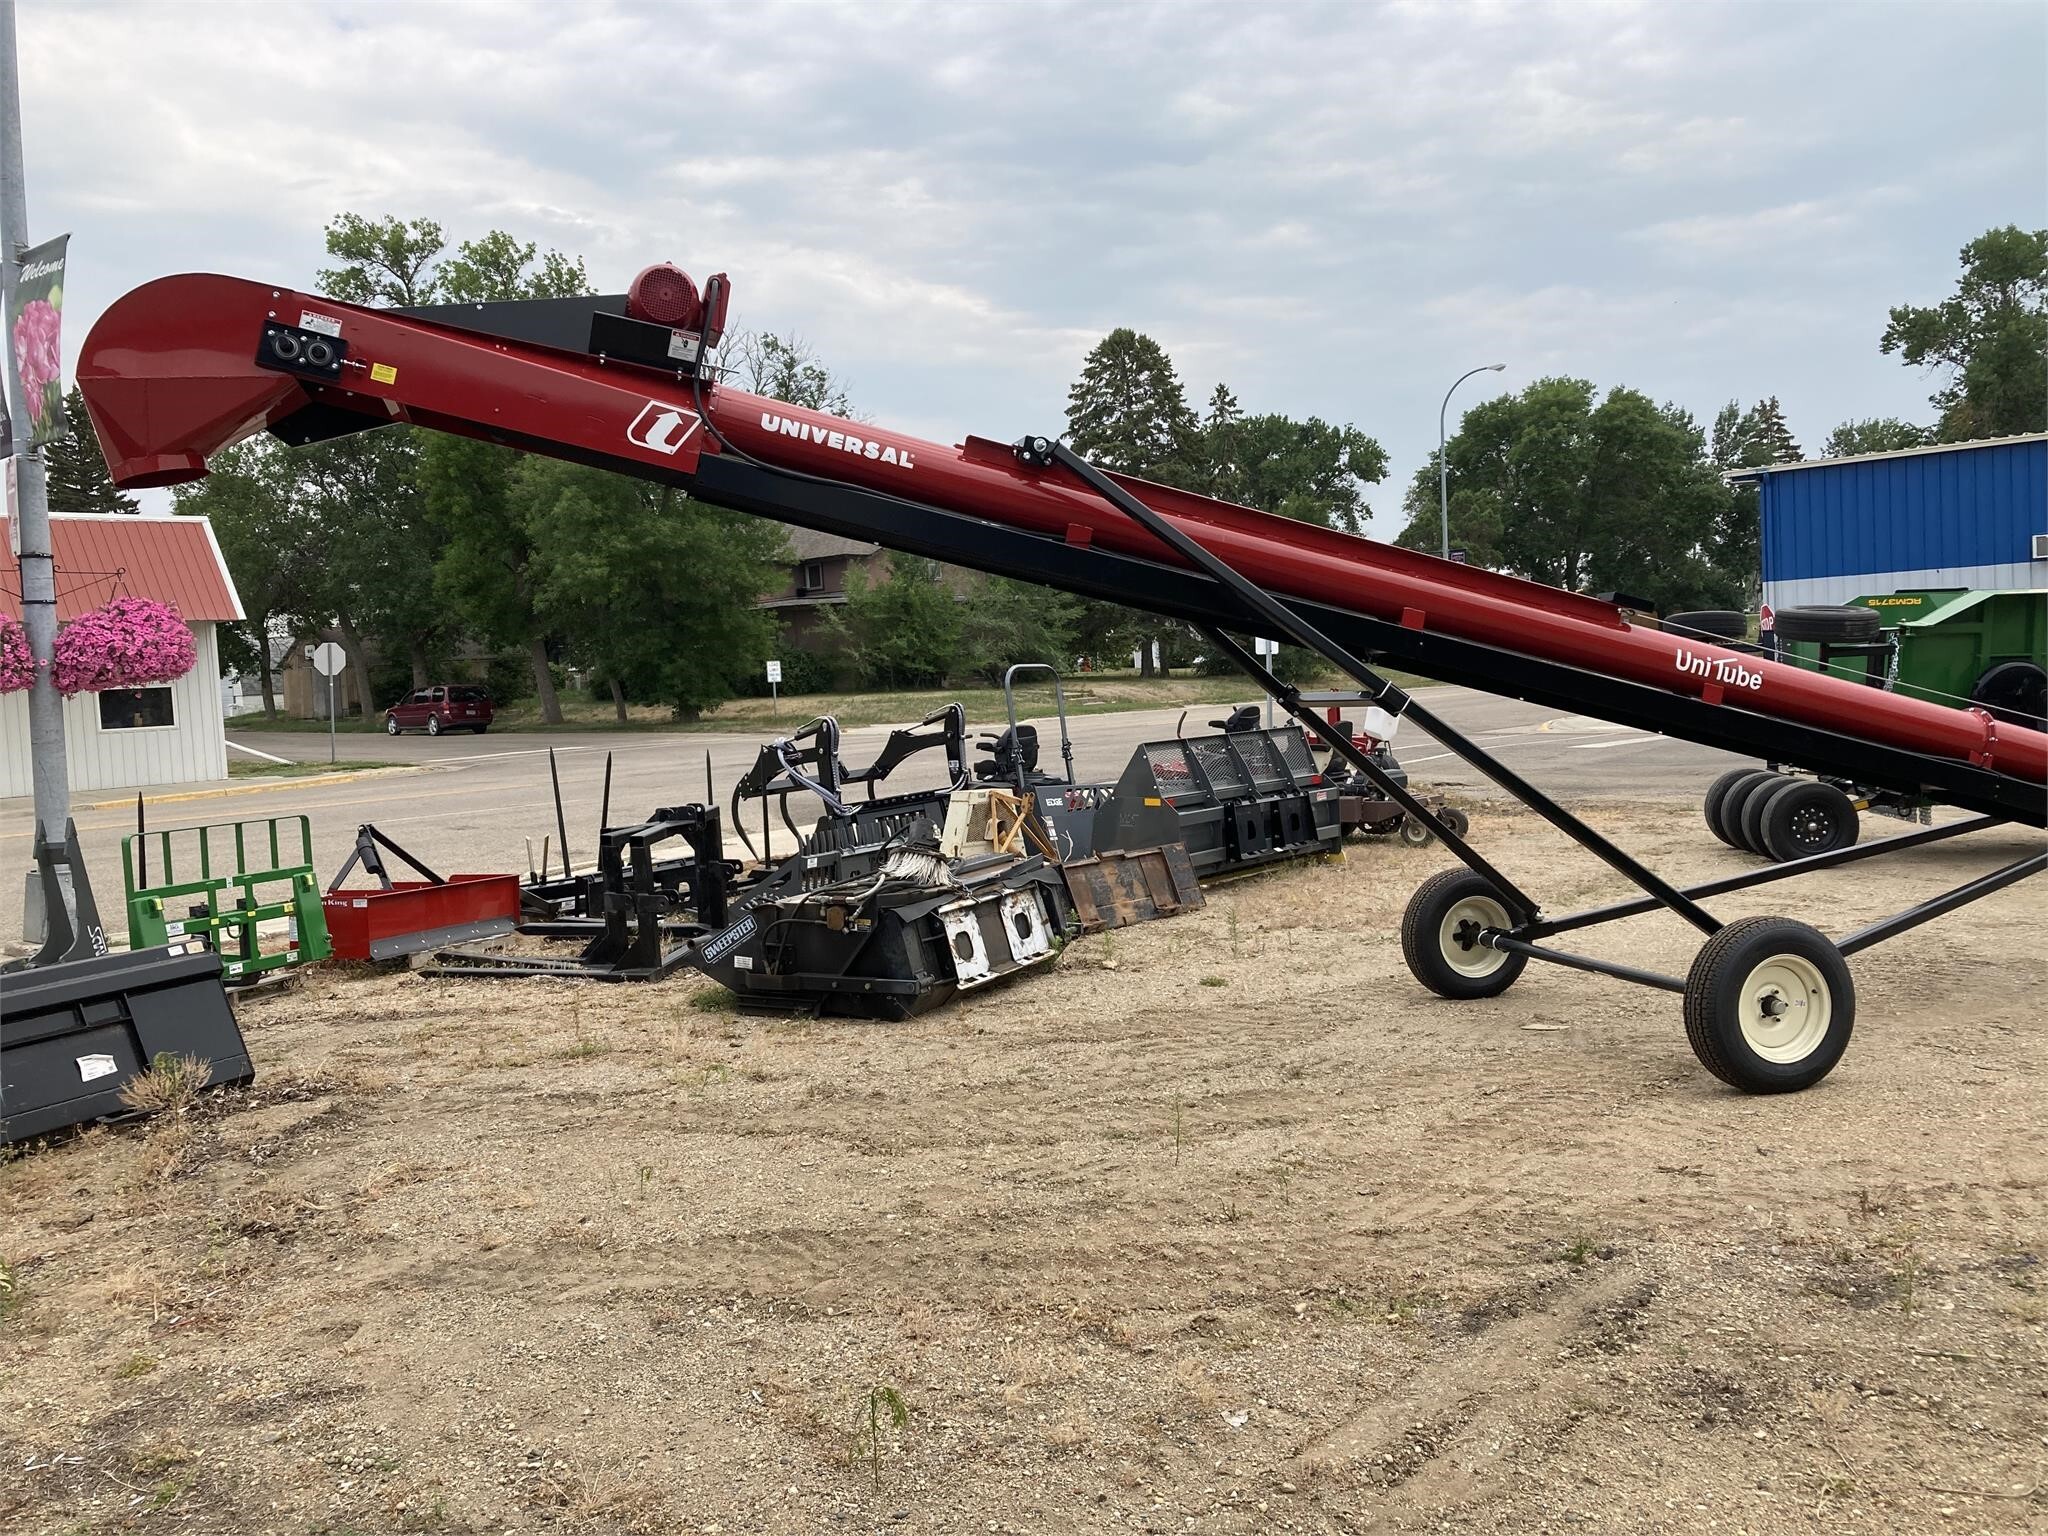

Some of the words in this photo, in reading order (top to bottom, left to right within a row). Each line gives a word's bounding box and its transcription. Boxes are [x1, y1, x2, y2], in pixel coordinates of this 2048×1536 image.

[20, 257, 65, 284] Welcome
[760, 412, 915, 470] UNIVERSAL
[1868, 597, 1922, 607] RCM3715
[1045, 797, 1064, 807] EDGE
[327, 899, 348, 907] King
[704, 918, 755, 960] SWEEPSTER
